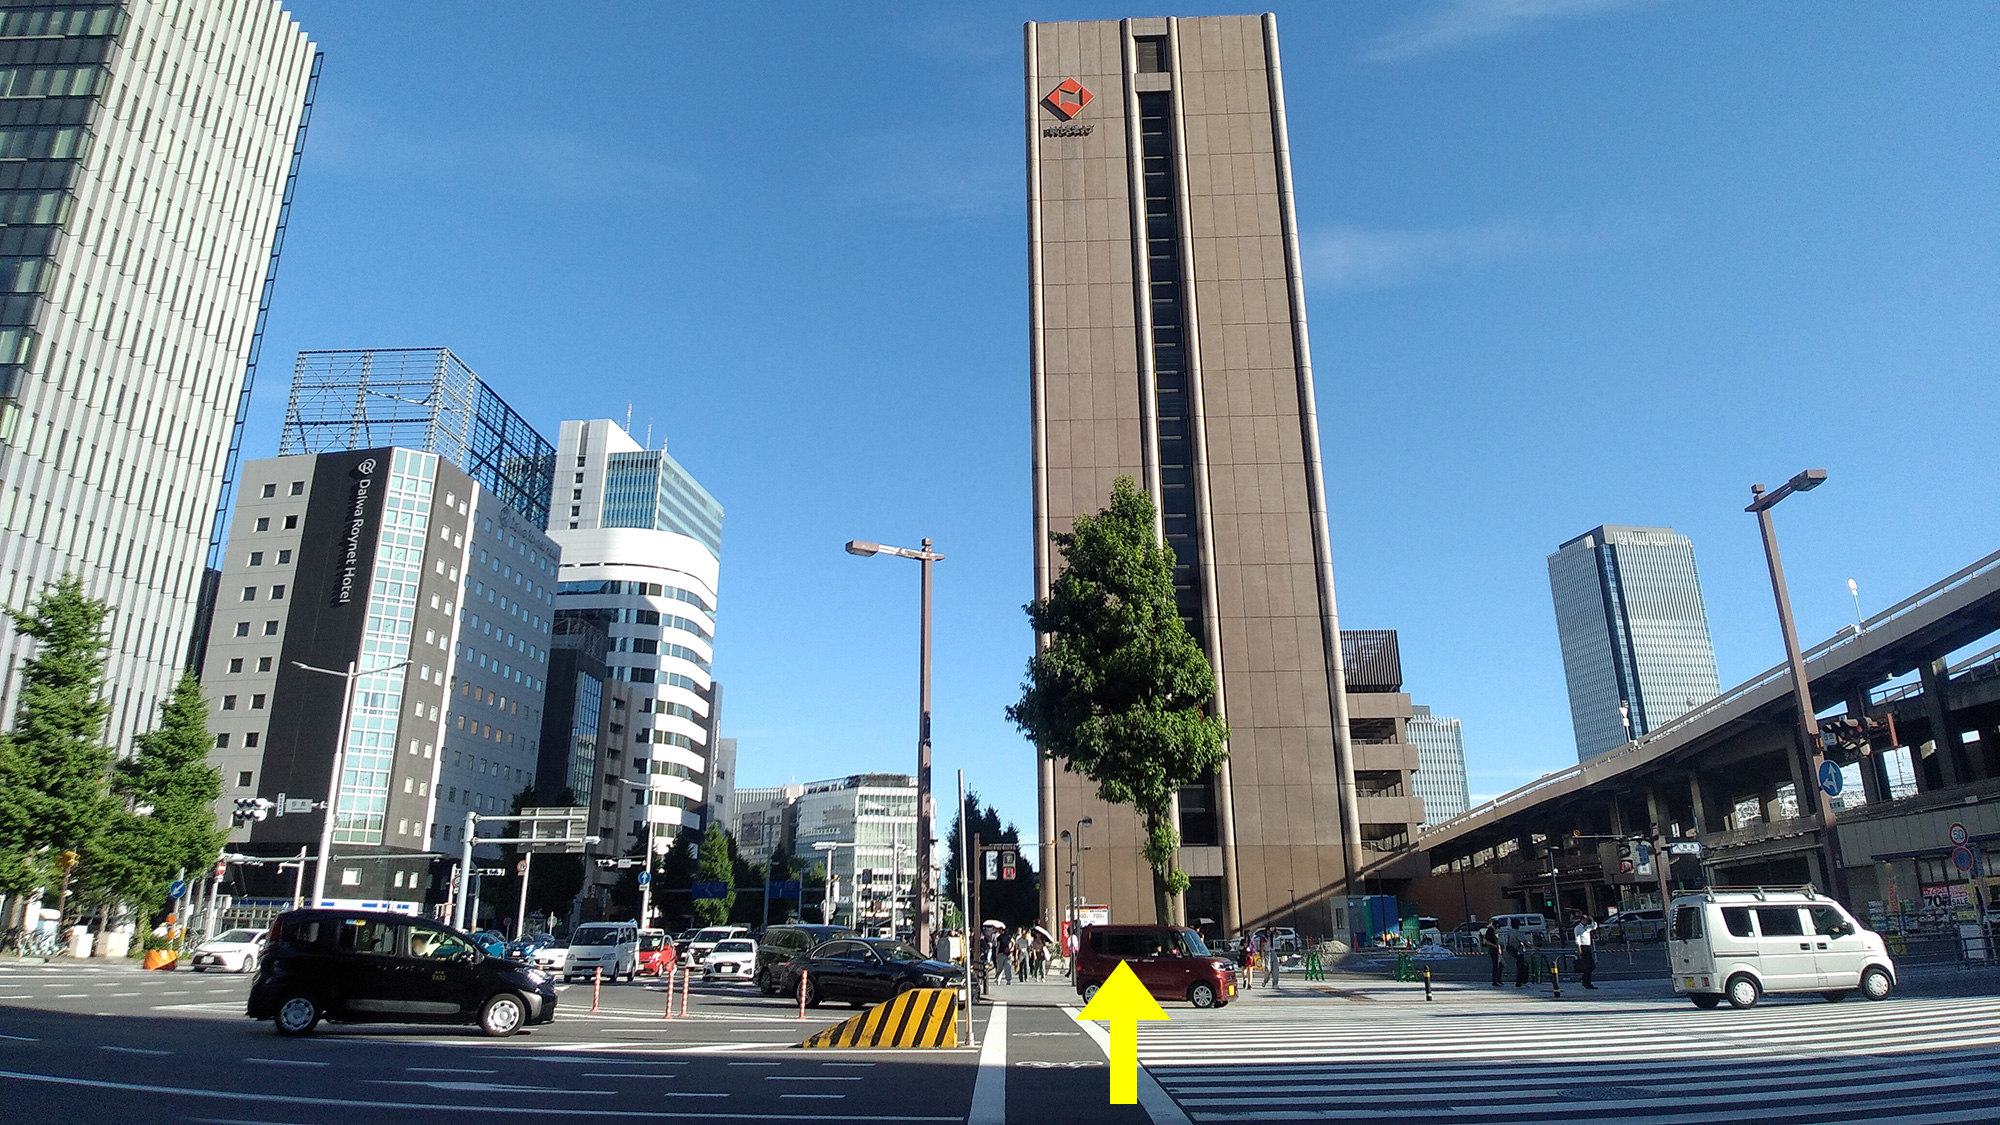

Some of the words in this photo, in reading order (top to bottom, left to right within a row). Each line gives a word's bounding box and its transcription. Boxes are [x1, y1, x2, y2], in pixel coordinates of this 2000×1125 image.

[354, 479, 371, 518] Daiwa
[346, 519, 365, 564] Roynet
[338, 566, 357, 603] Hotel
[1952, 829, 1965, 841] 50
[1952, 897, 1969, 906] SALE
